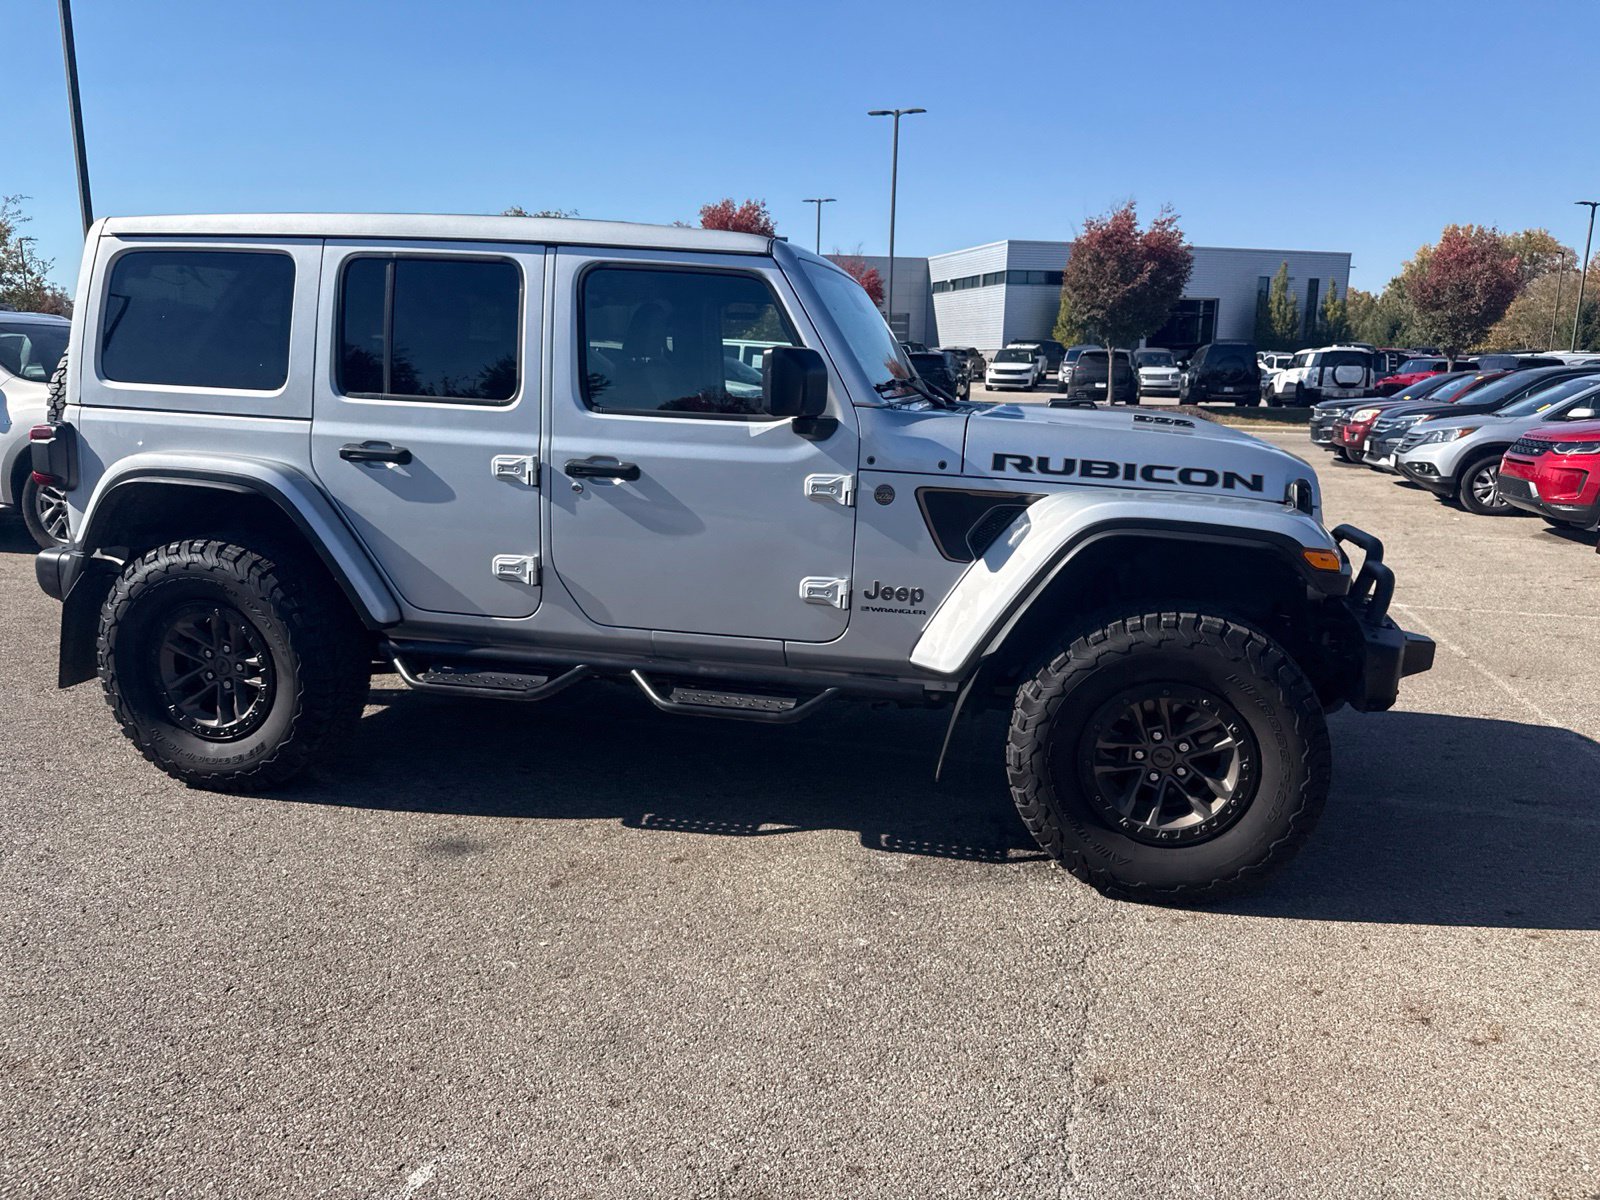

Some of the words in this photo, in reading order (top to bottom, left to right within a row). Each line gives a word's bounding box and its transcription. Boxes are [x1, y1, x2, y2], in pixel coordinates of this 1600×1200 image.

[991, 452, 1264, 492] RUBICON
[863, 579, 925, 606] Jeep
[869, 606, 926, 615] WRANGLER
